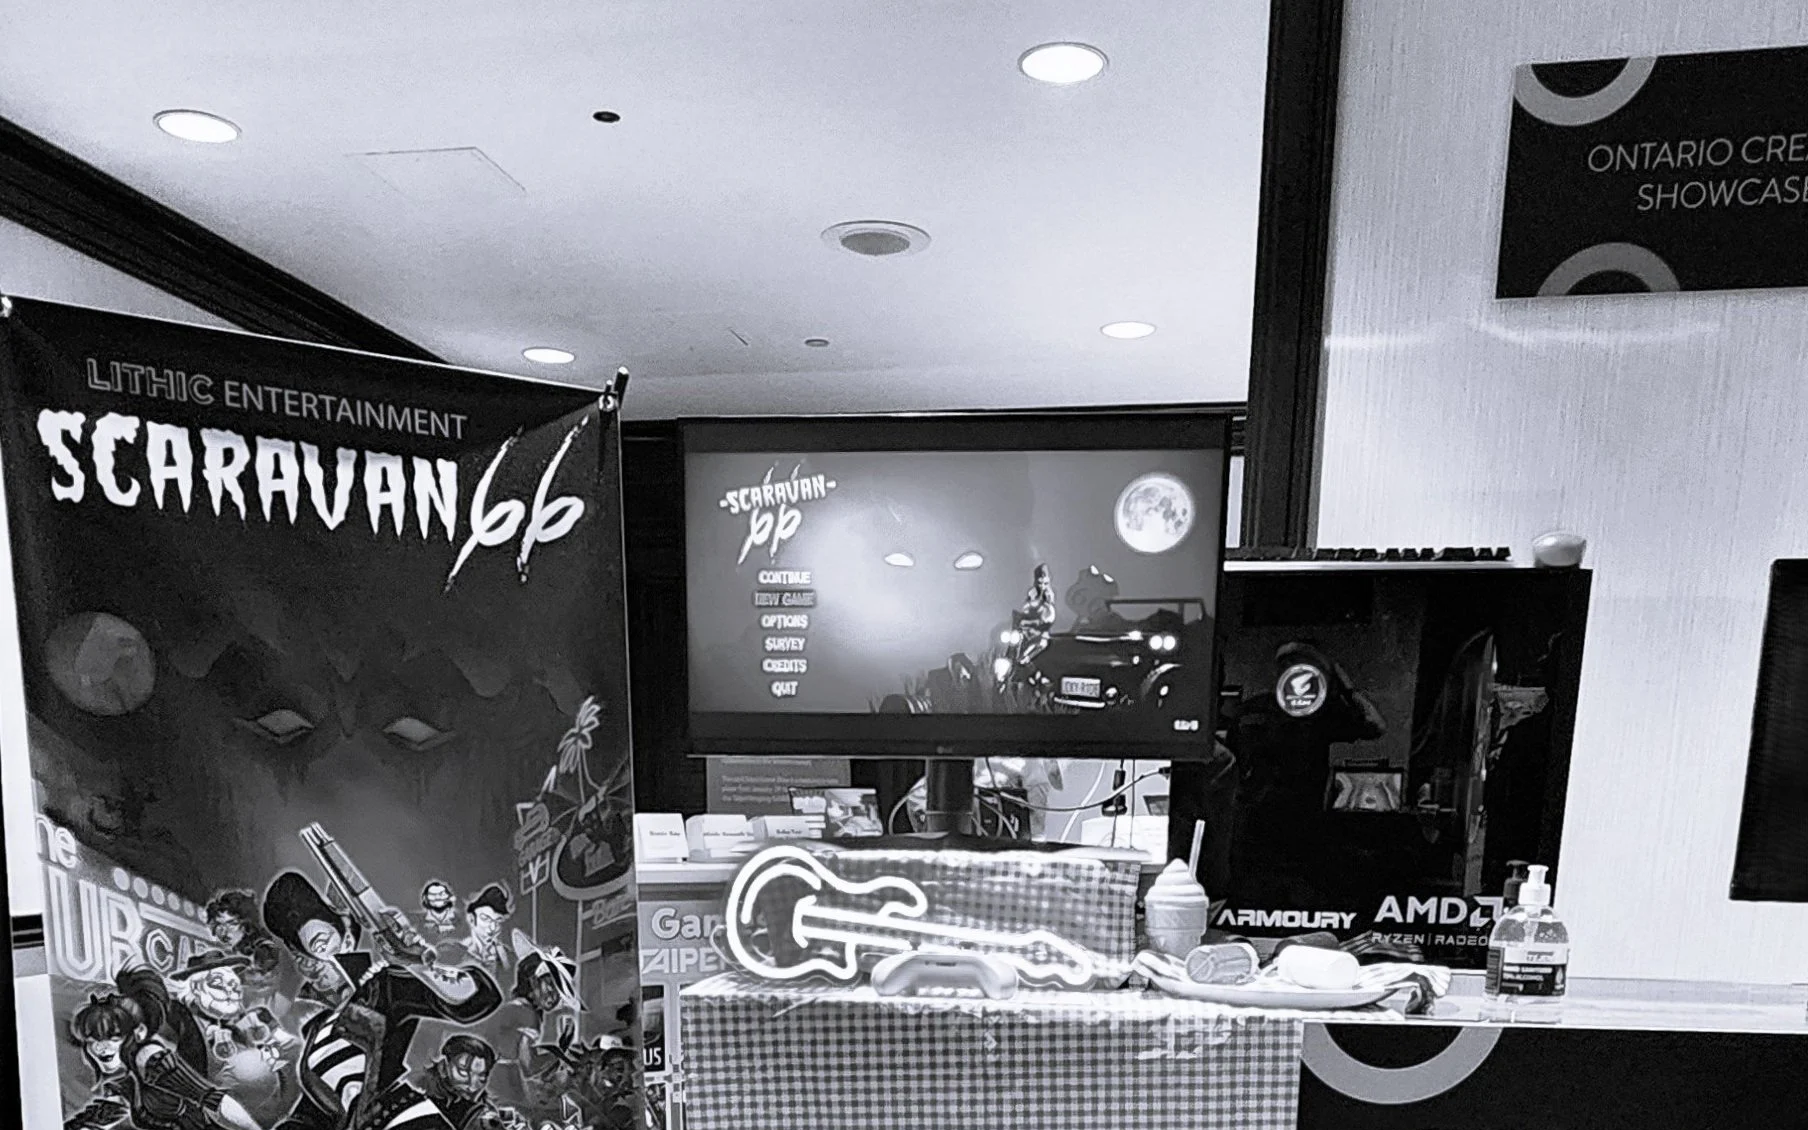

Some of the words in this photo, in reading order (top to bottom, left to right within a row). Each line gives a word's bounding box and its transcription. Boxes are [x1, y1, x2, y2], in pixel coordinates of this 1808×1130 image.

[1588, 138, 1734, 173] ONTARIO
[1741, 133, 1808, 164] CRE
[86, 357, 214, 405] LITHIC
[224, 381, 468, 440] ENTERTAINMENT
[36, 408, 459, 545] SCARAVAN
[443, 415, 590, 594] 66
[758, 570, 812, 584] CONTINUE
[782, 592, 814, 606] GAME
[761, 614, 808, 628] OPTIONS
[765, 637, 805, 651] SURVEY
[762, 658, 807, 673] CREDITS
[771, 681, 798, 696] QUIT
[1216, 908, 1357, 930] ARMOURY
[1373, 895, 1467, 924] AMD
[1372, 932, 1426, 945] RYZEN
[1435, 933, 1488, 947] RADEO
